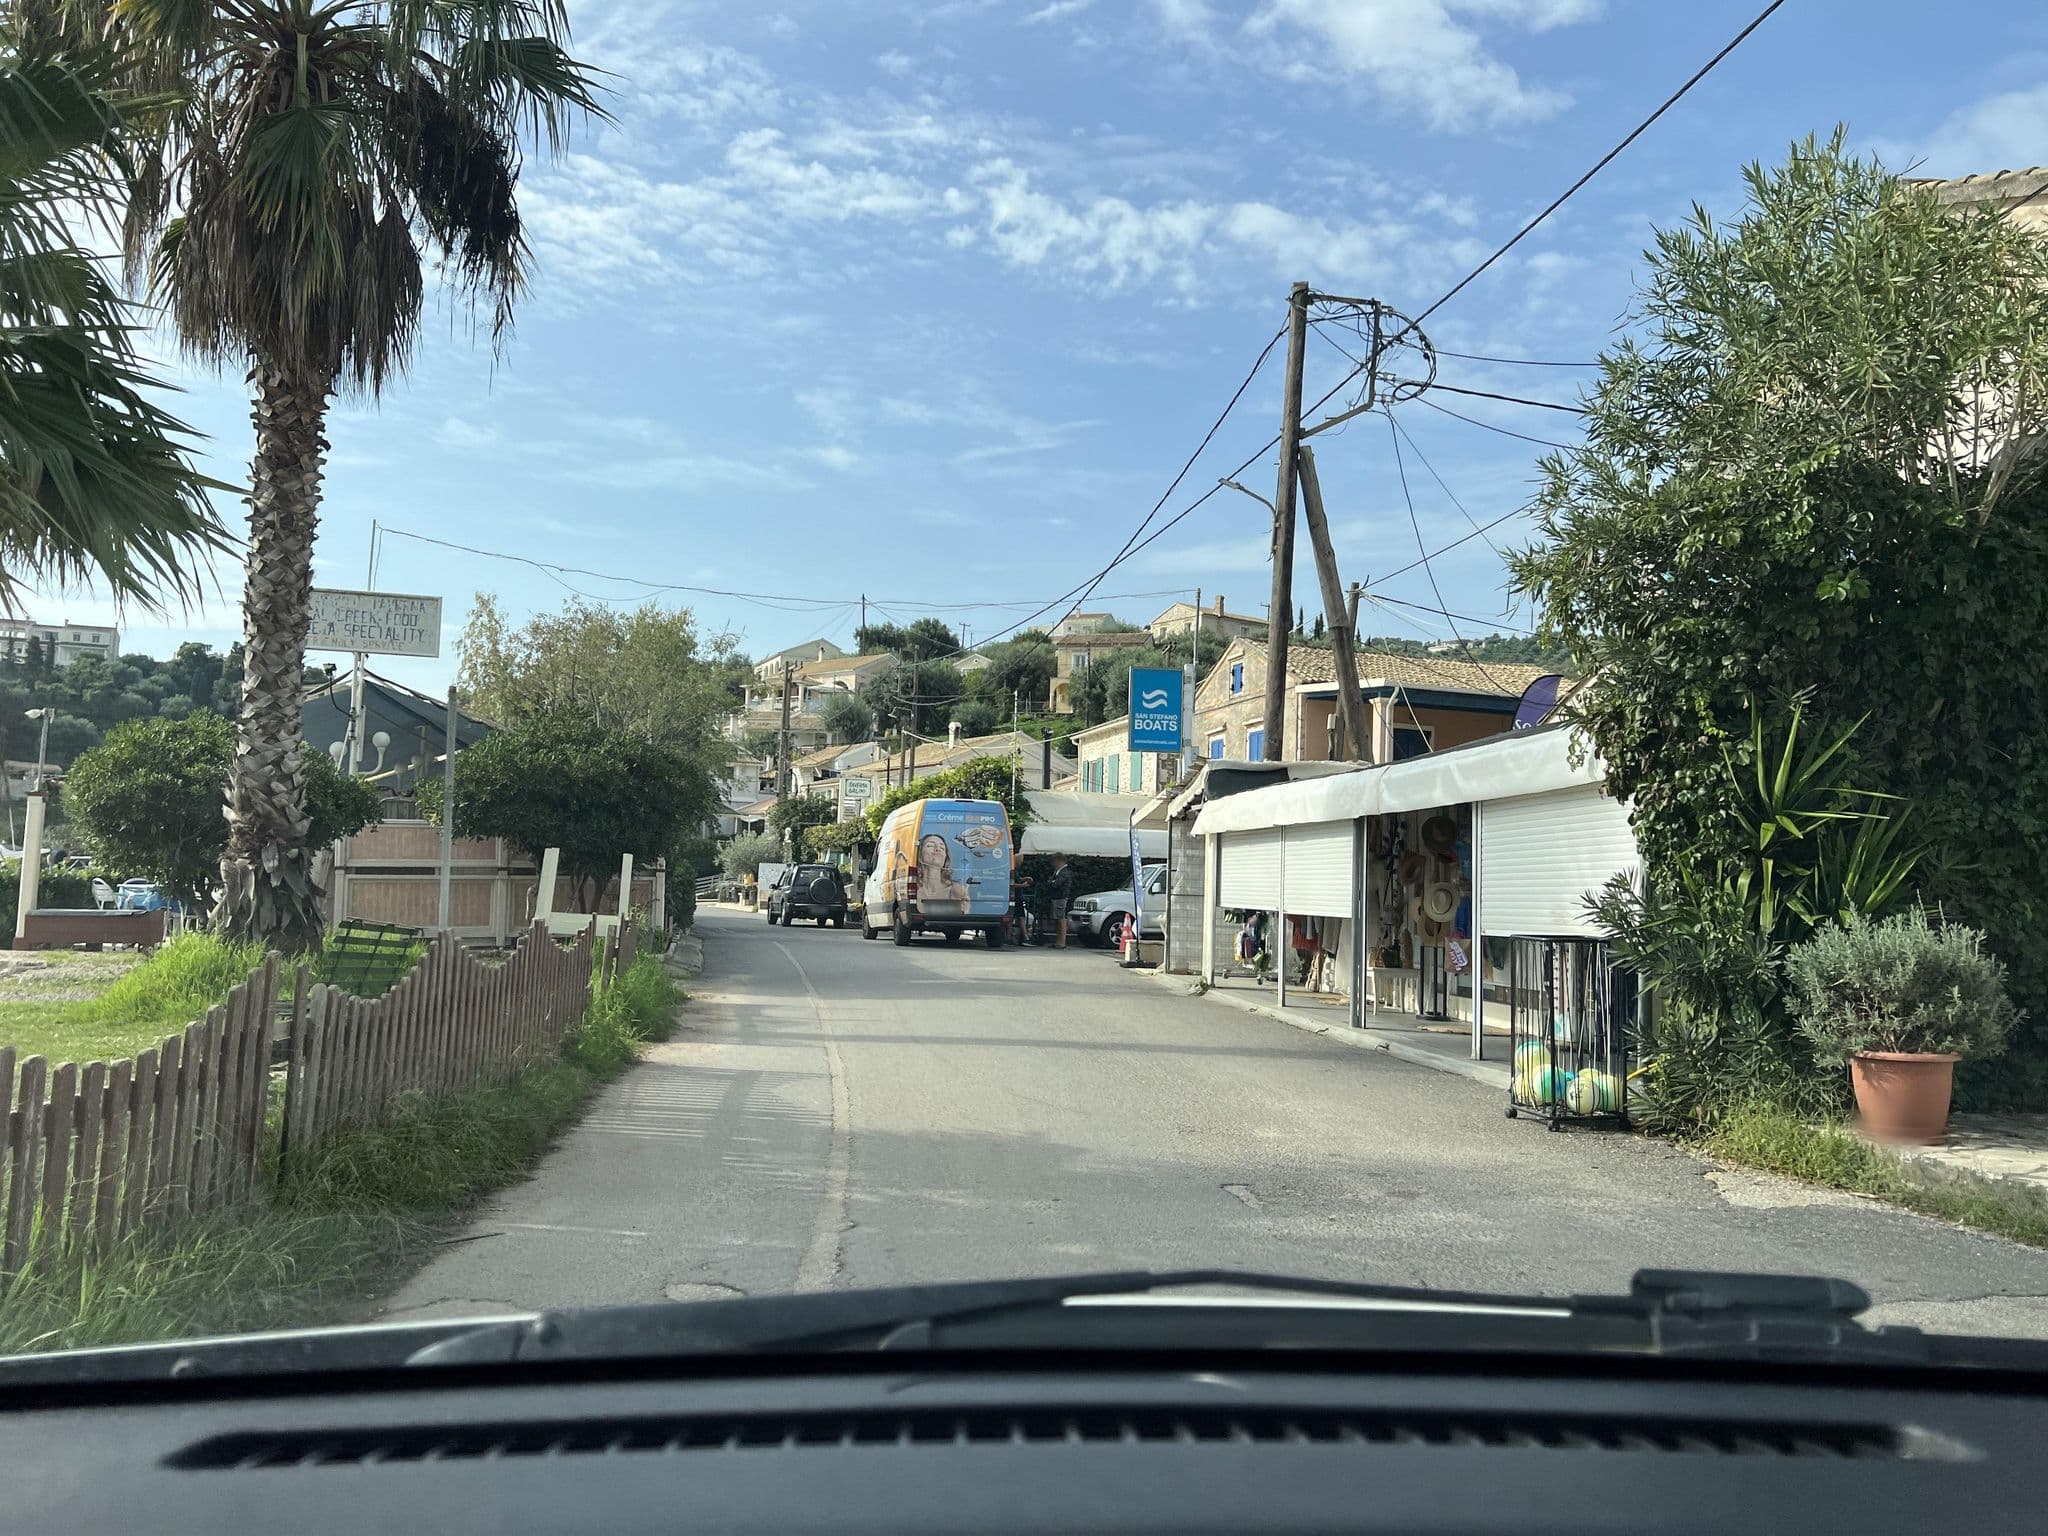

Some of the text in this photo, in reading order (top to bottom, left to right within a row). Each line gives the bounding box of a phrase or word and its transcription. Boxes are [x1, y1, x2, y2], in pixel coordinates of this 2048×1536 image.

[344, 623, 425, 642] SPECIALITY
[1149, 713, 1178, 721] STEFANO
[1134, 719, 1178, 731] BOATS
